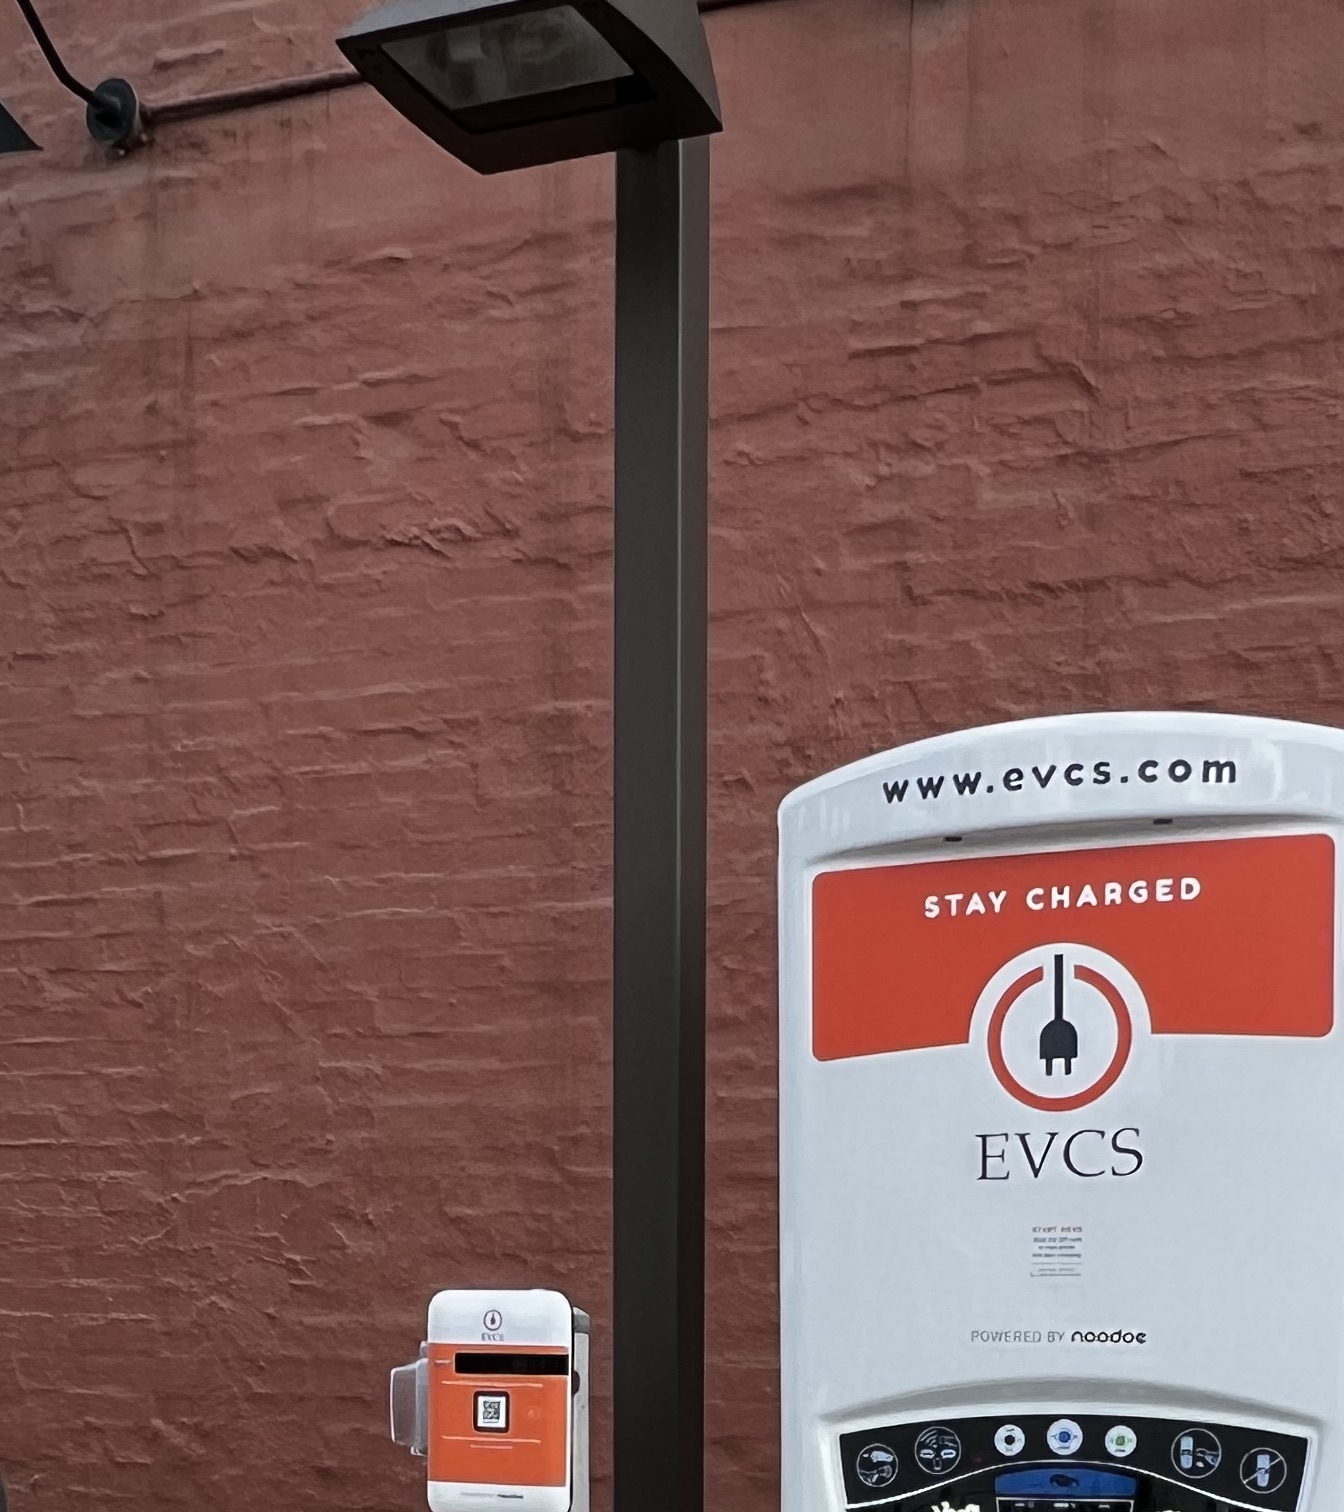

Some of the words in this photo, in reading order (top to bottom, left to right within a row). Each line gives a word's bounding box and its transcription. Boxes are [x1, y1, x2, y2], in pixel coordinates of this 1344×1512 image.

[883, 758, 1237, 804] www.evcs.com
[924, 890, 1008, 919] STAY
[1026, 877, 1202, 911] CHARGED
[974, 1126, 1144, 1182] EVCS
[970, 1330, 1042, 1343] POWERED
[1047, 1330, 1066, 1343] BY
